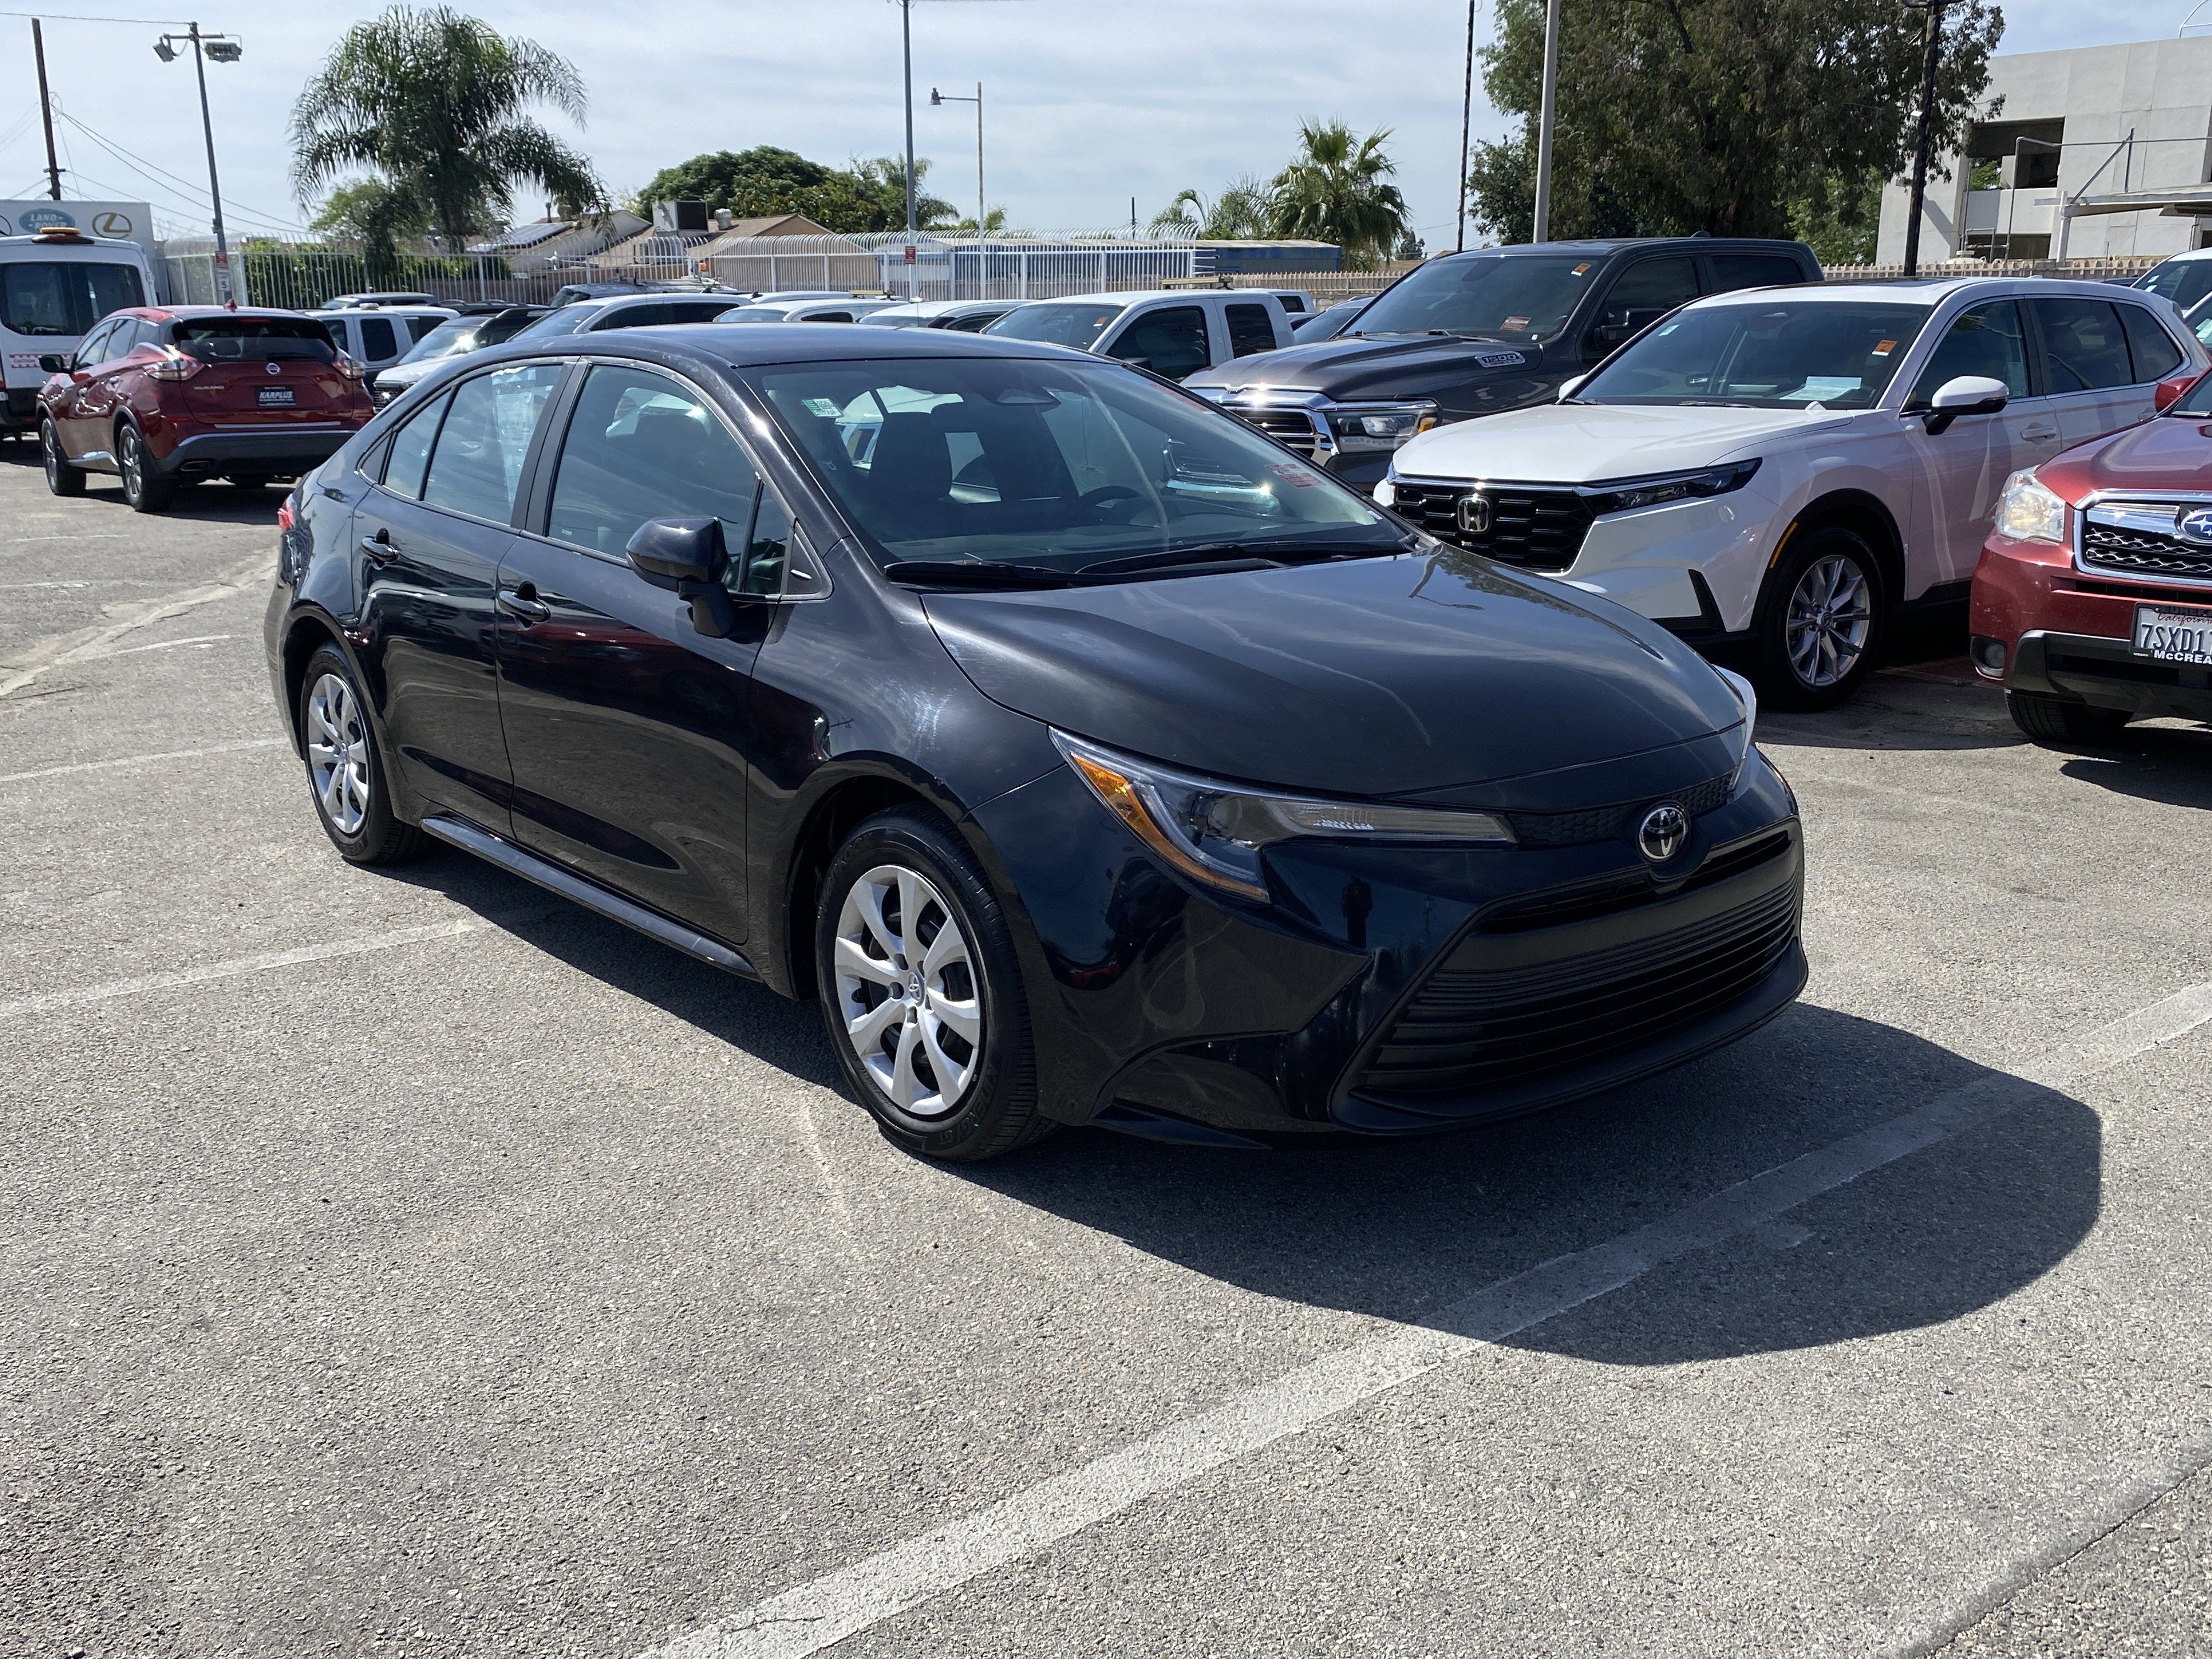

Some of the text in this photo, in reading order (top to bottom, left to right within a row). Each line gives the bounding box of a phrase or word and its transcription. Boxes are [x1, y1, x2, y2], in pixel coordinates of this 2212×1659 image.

[1483, 354, 1517, 363] 1500
[259, 391, 293, 399] KARPLUS
[2141, 623, 2212, 655] 7SXD1
